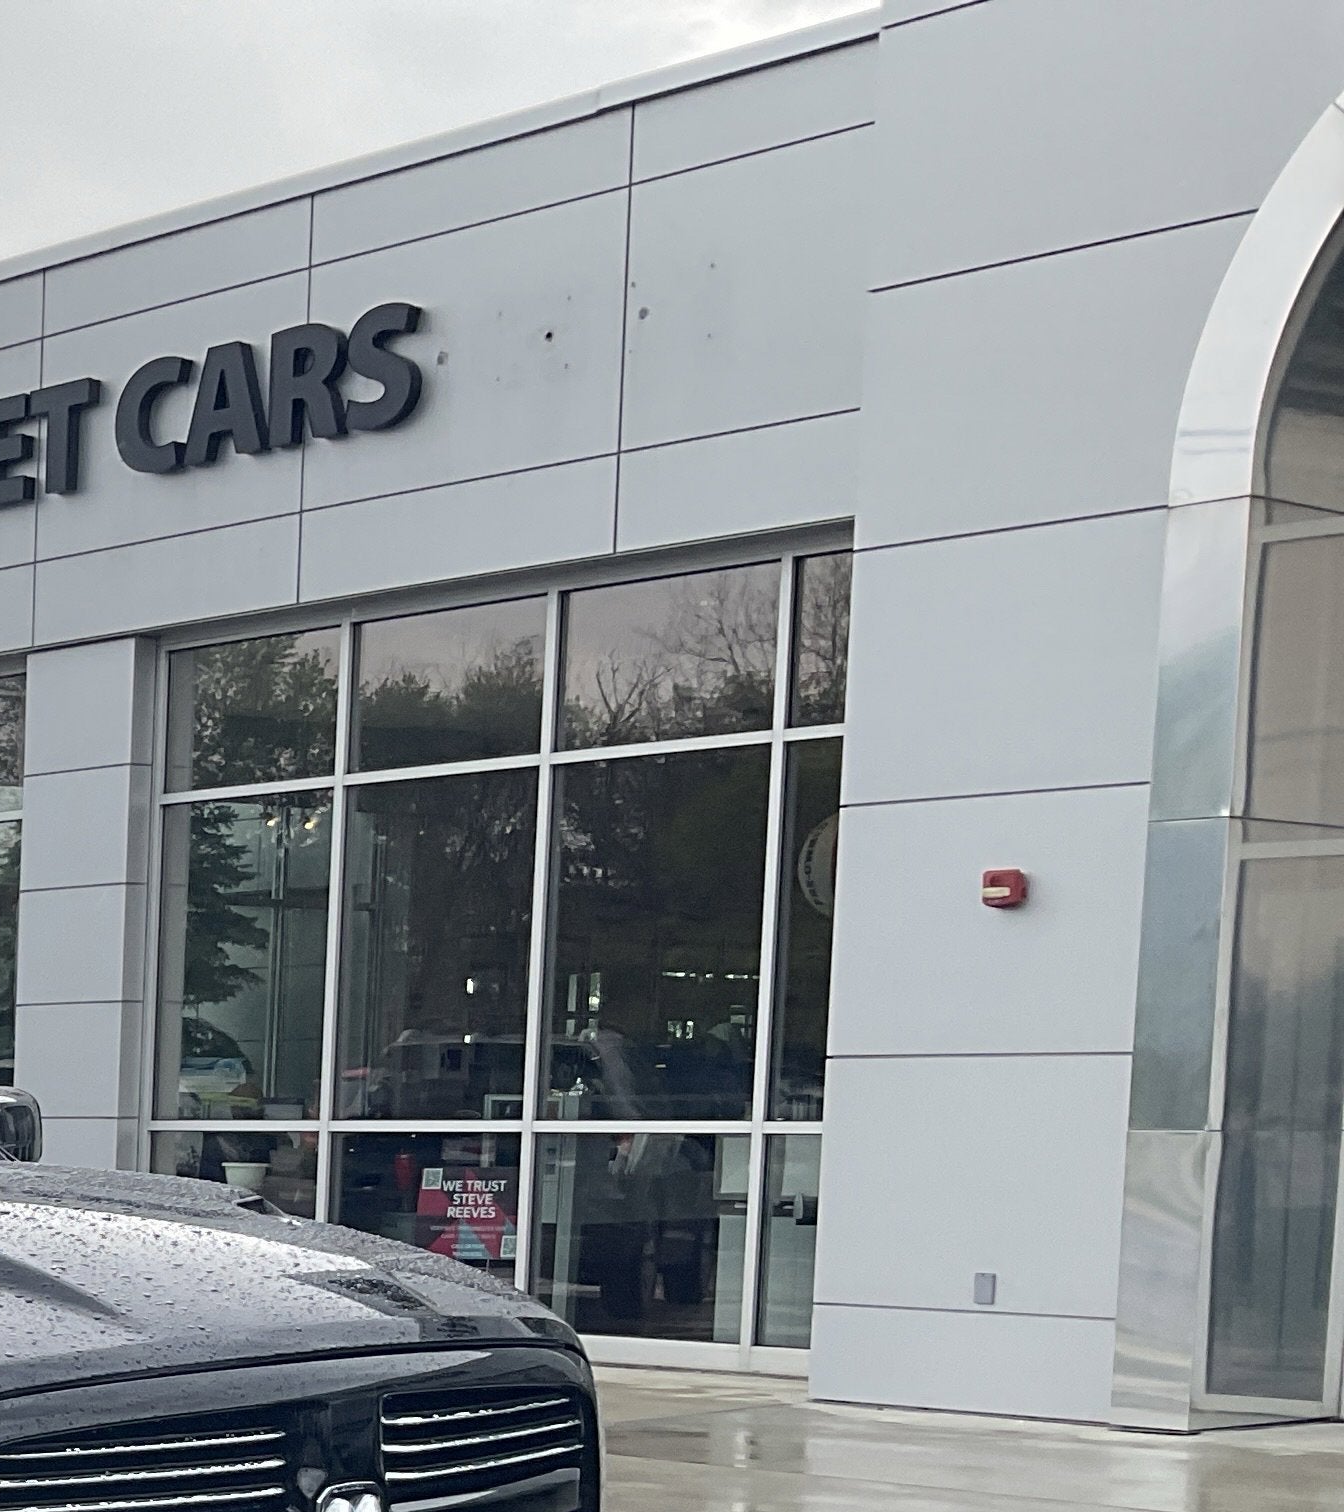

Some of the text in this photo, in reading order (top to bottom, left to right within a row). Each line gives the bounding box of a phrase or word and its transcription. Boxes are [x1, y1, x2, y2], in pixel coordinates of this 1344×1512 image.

[115, 303, 422, 474] CARS
[442, 1180, 507, 1192] WE TRUST
[452, 1193, 494, 1205] STEVE
[447, 1206, 496, 1219] REEVES
